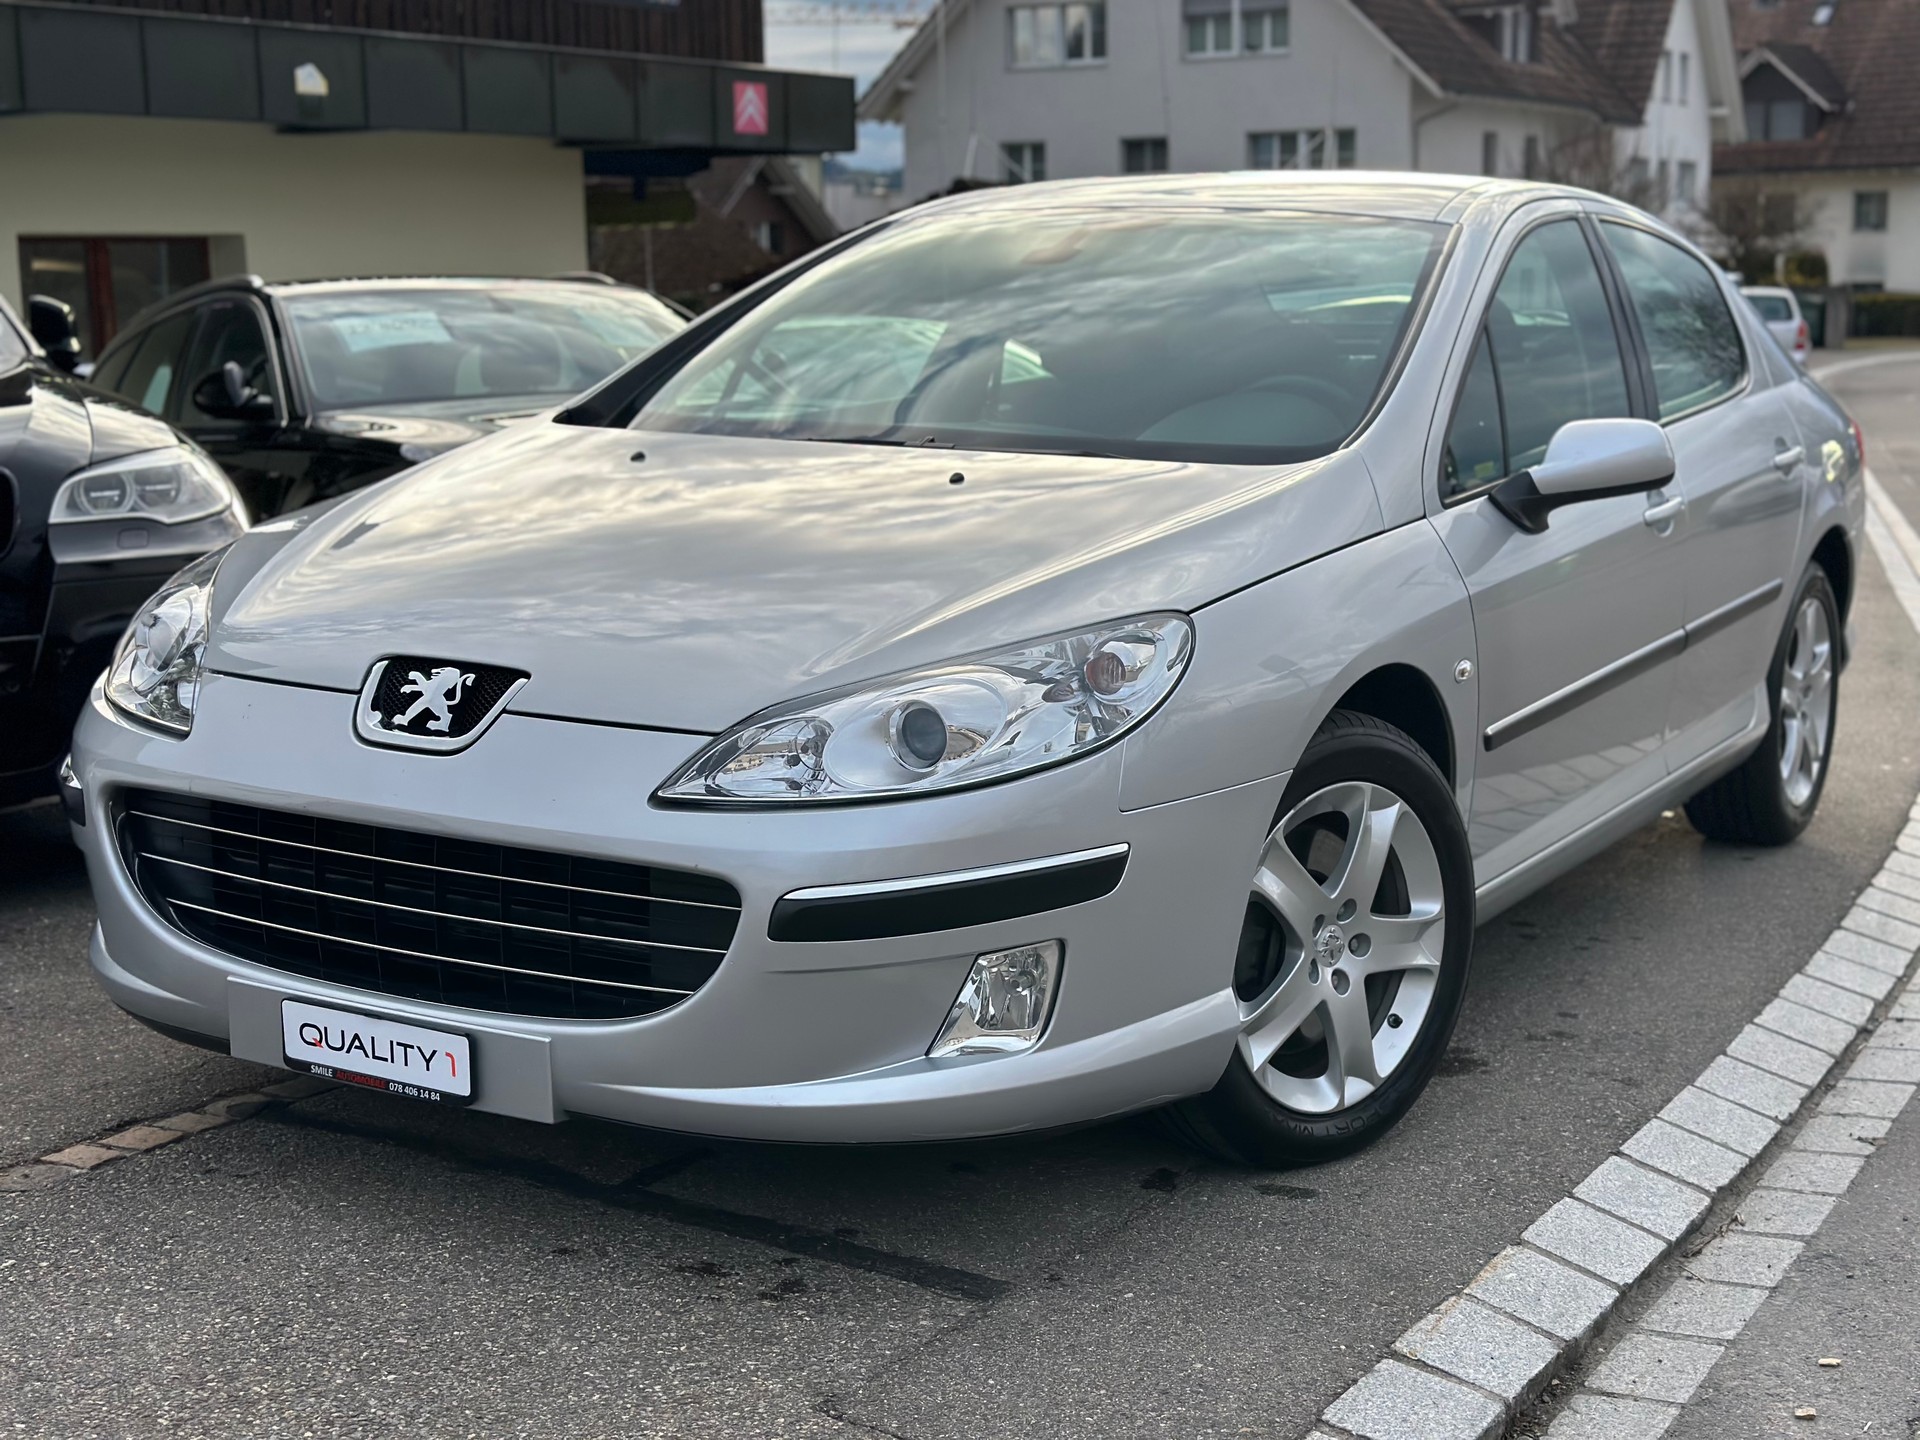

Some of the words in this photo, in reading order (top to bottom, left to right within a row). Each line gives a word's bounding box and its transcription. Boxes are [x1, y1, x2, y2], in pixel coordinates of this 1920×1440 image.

[299, 1022, 438, 1072] QUALITY
[444, 1051, 456, 1078] 1
[310, 1064, 333, 1078] SMILE
[389, 1082, 403, 1093] 078
[404, 1085, 418, 1096] 406
[420, 1089, 429, 1099] 14
[430, 1091, 440, 1101] 84
